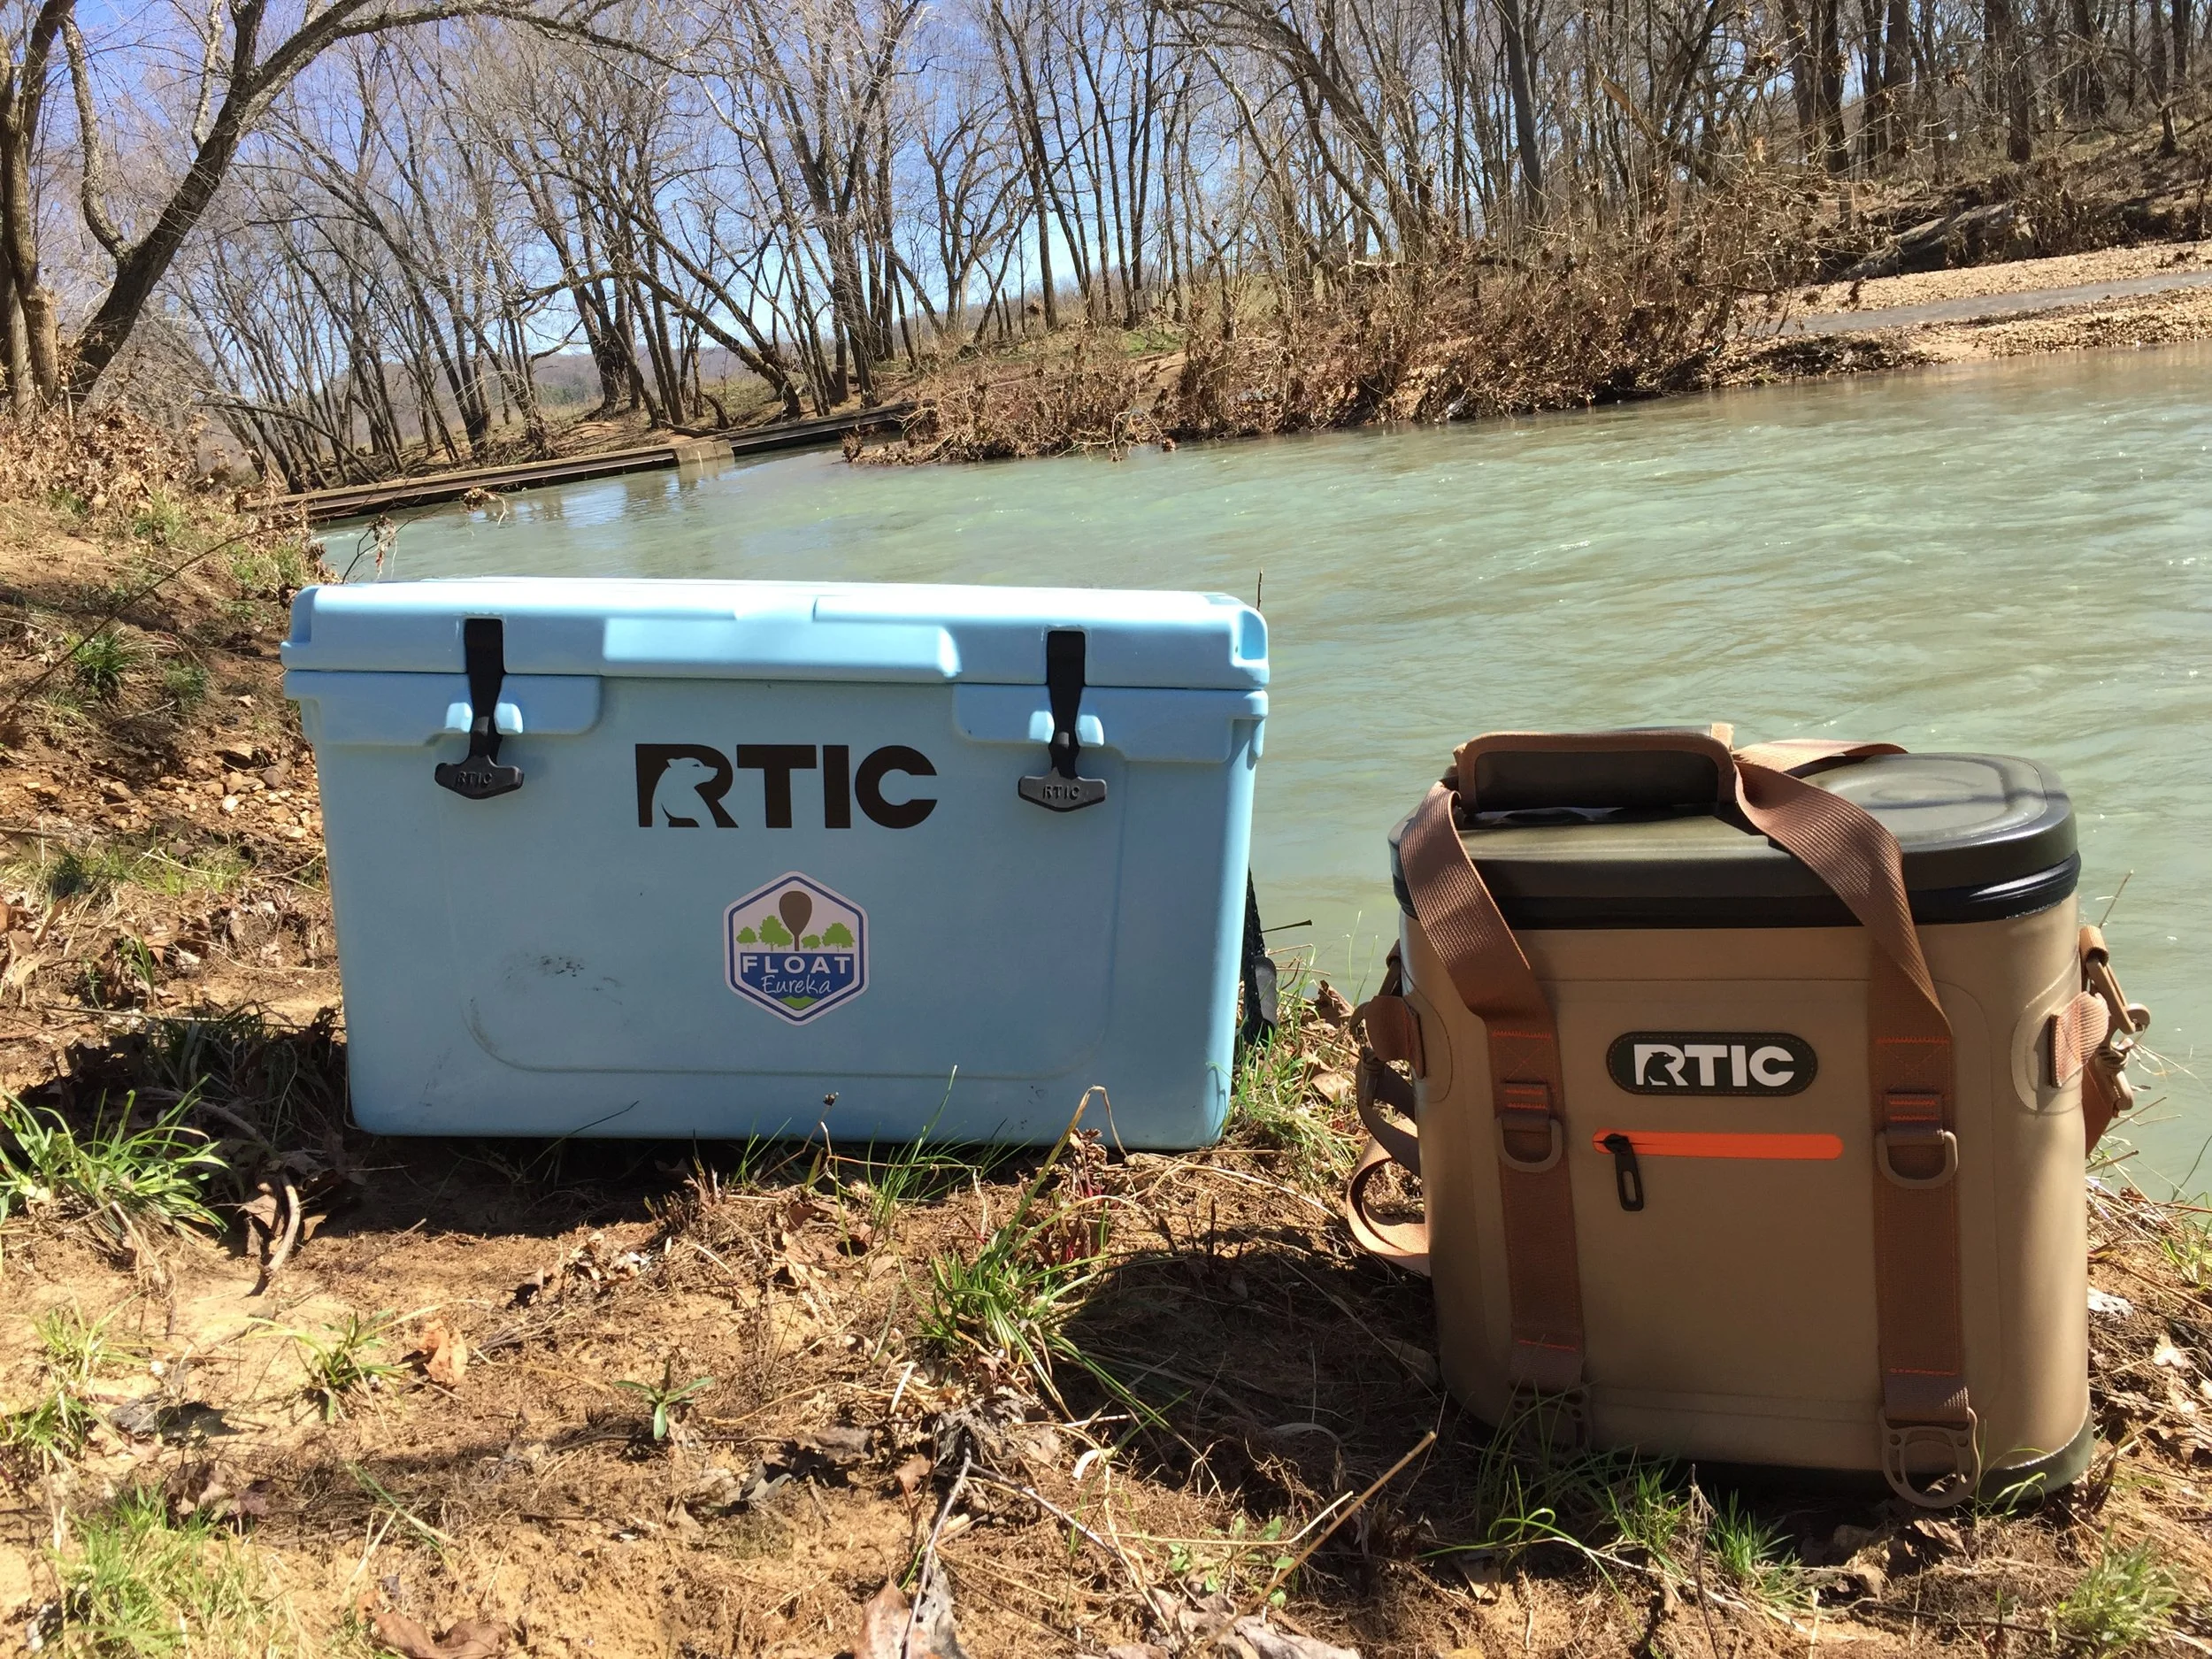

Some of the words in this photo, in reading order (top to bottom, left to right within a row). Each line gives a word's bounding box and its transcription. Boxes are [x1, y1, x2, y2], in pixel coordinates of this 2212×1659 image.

[456, 771, 494, 787] RTIC
[634, 743, 938, 829] RTIC
[1042, 784, 1080, 801] RTIC
[741, 955, 850, 974] FLOAT
[760, 974, 832, 995] Eureka
[1633, 1043, 1795, 1087] RTIC
